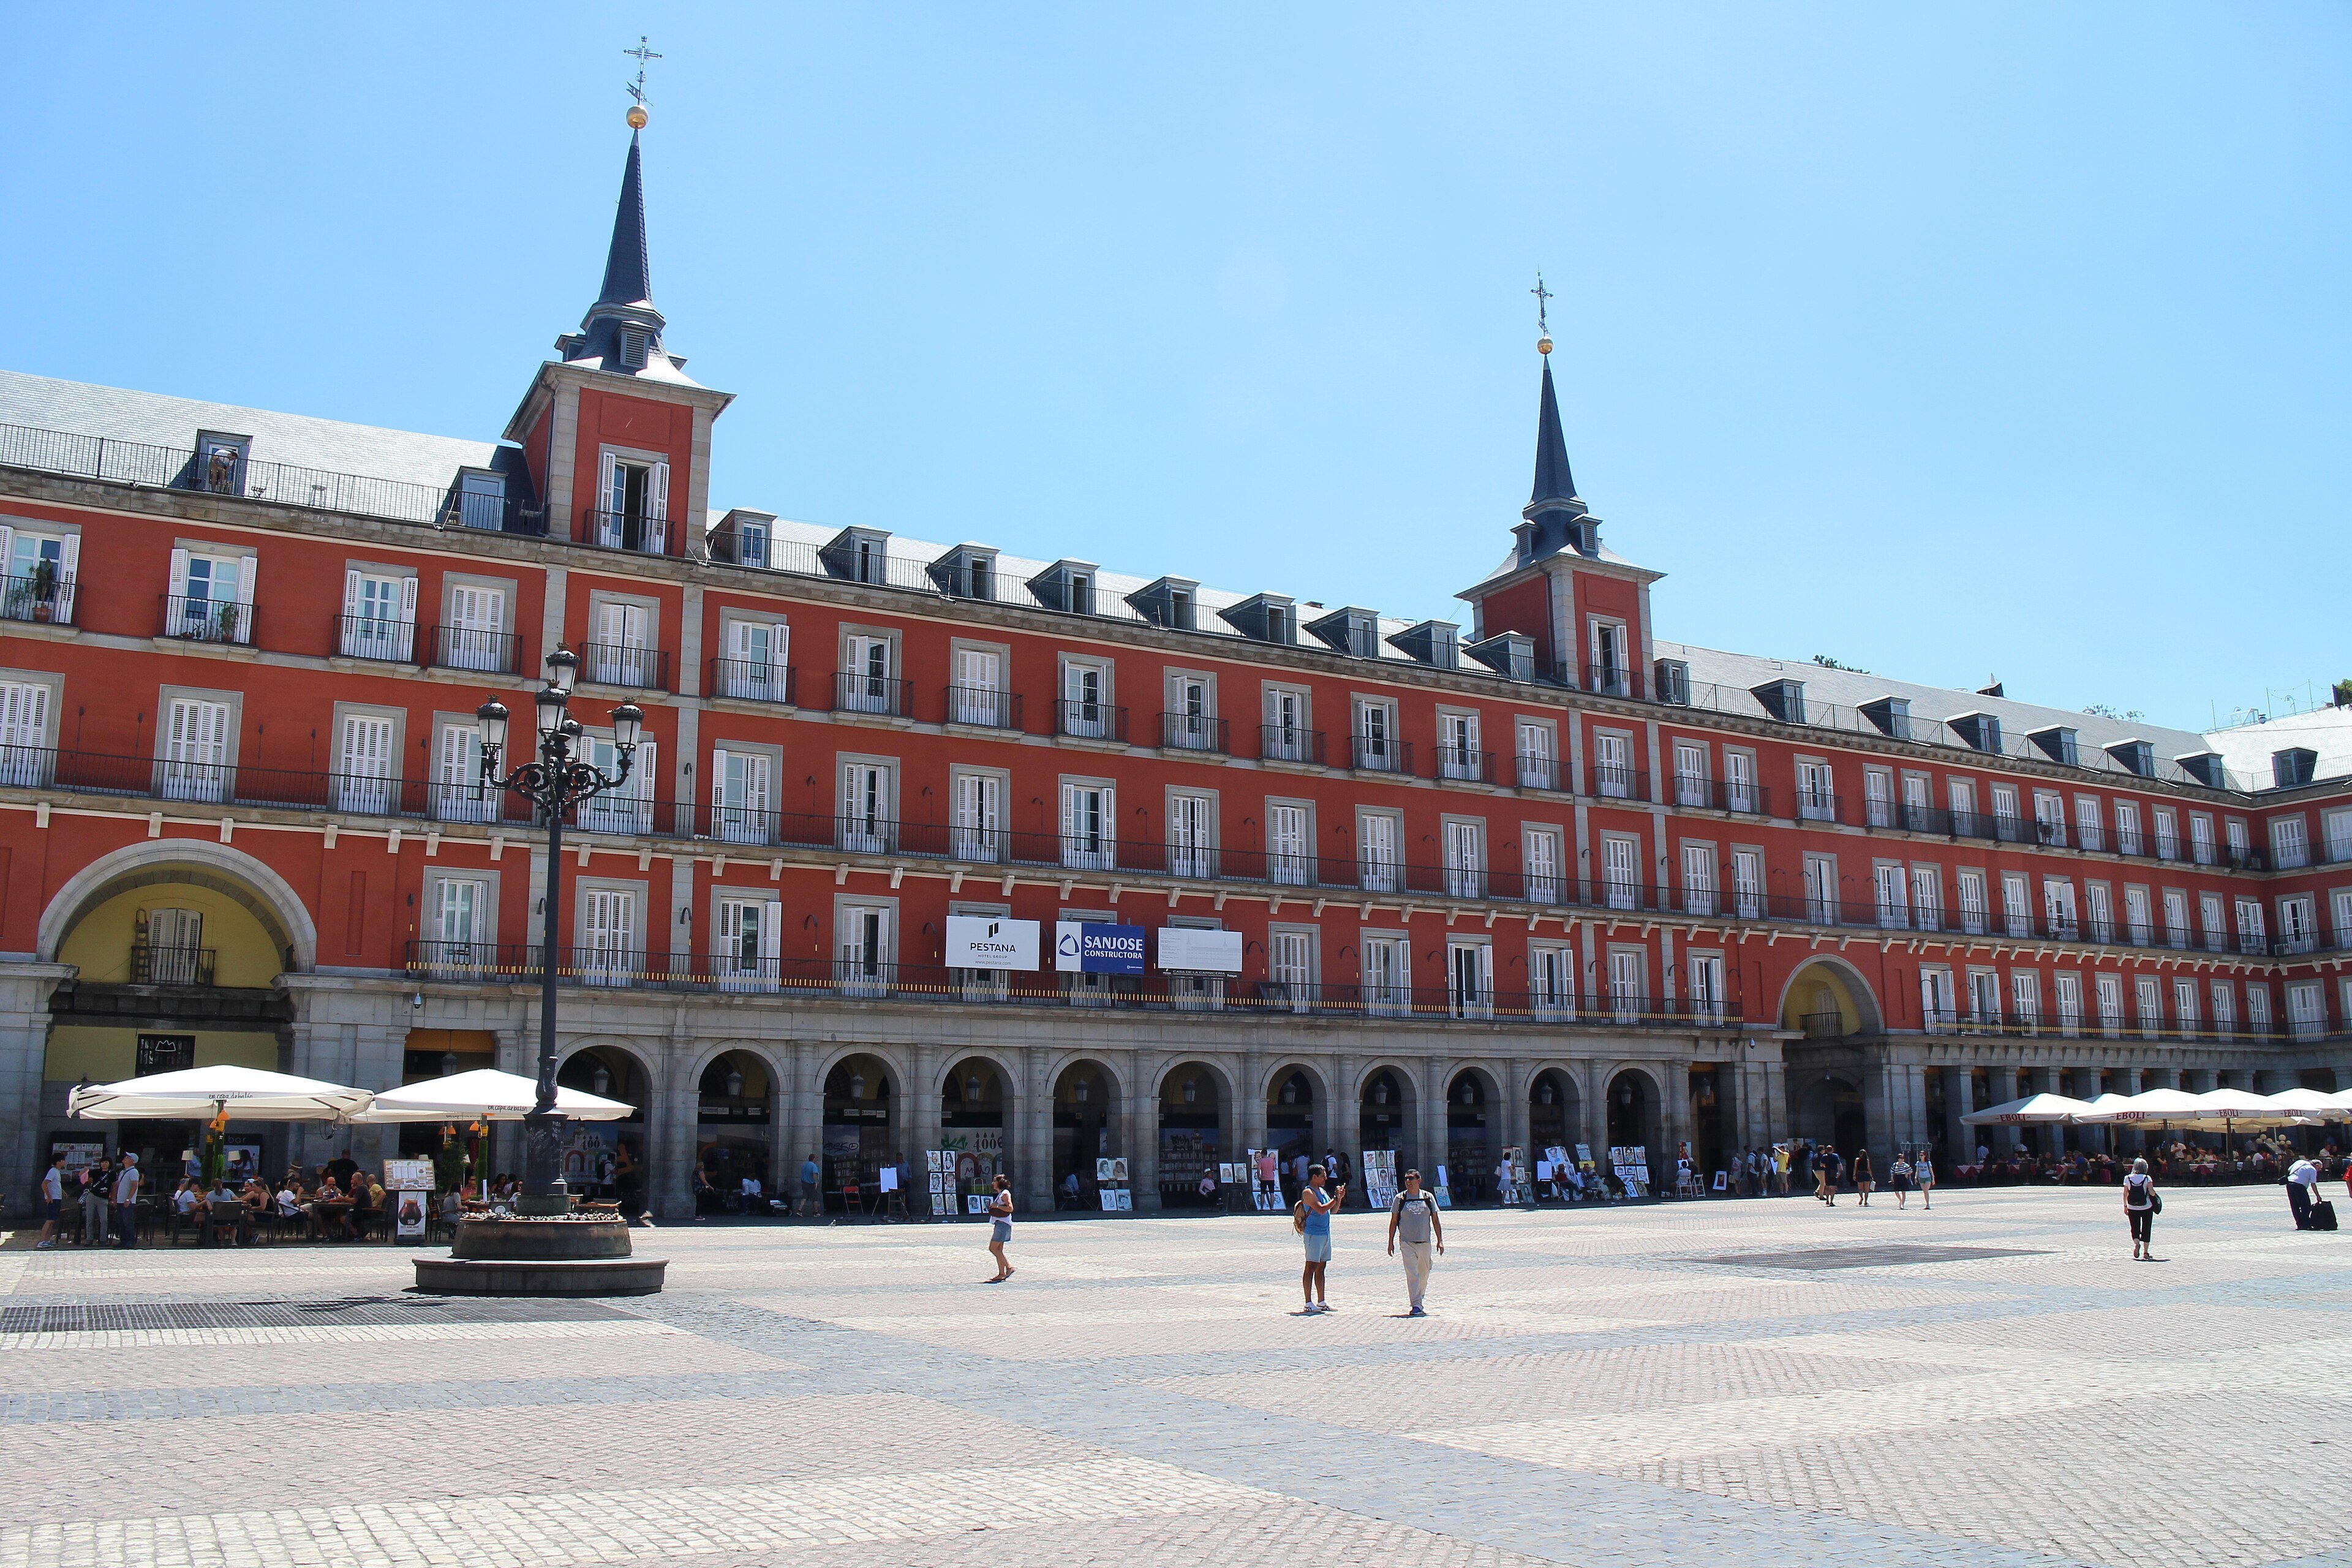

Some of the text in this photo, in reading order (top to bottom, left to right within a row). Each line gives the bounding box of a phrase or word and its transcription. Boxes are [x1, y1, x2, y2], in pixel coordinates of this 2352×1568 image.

[970, 943, 1016, 952] PESTANA
[1084, 935, 1143, 951] SANJOSE
[1084, 950, 1142, 959] CONSTRUCTORA
[228, 1135, 246, 1144] bar
